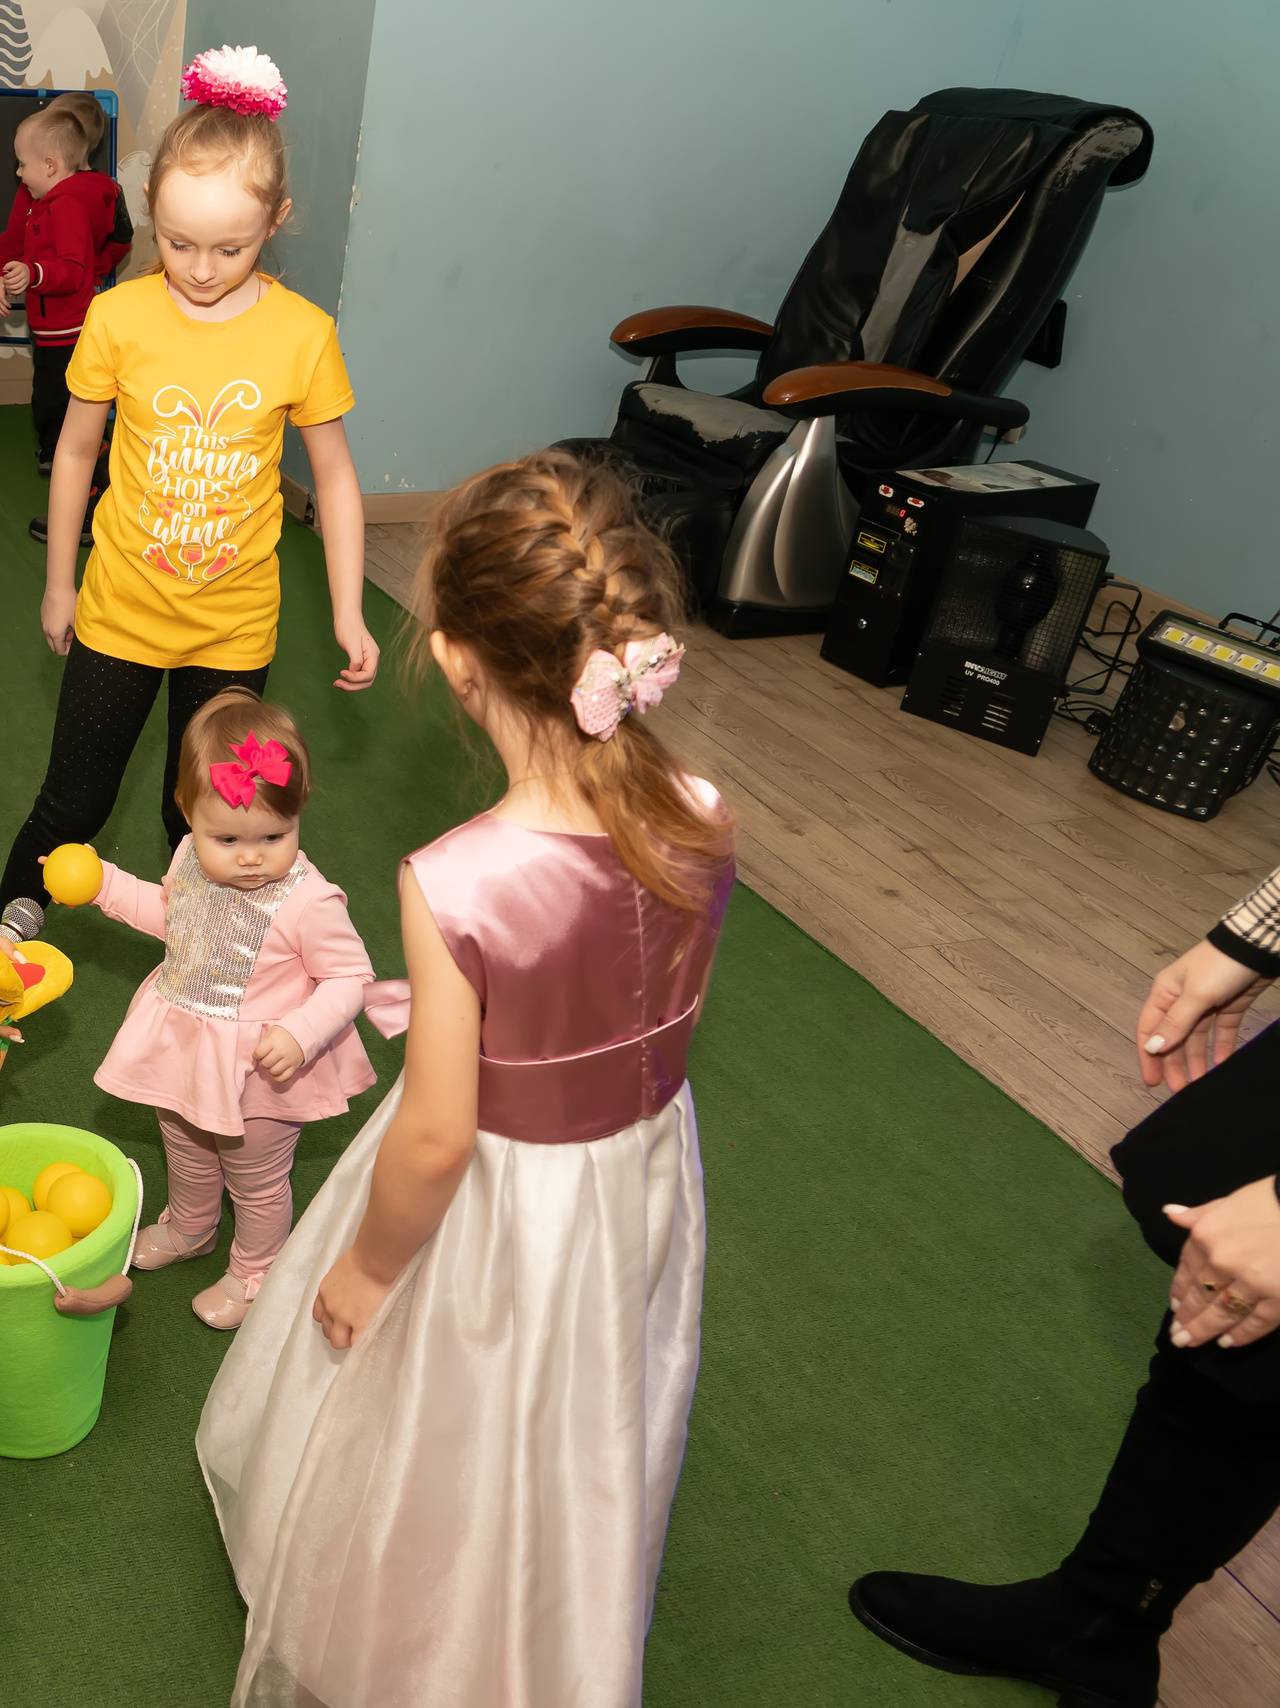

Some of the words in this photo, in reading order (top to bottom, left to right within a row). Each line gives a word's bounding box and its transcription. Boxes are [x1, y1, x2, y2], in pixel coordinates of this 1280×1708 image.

[178, 425, 230, 449] This
[140, 436, 261, 490] Bunny
[163, 476, 232, 502] HOPS
[182, 503, 207, 518] on
[964, 669, 975, 677] UV
[976, 673, 1001, 686] PRO400
